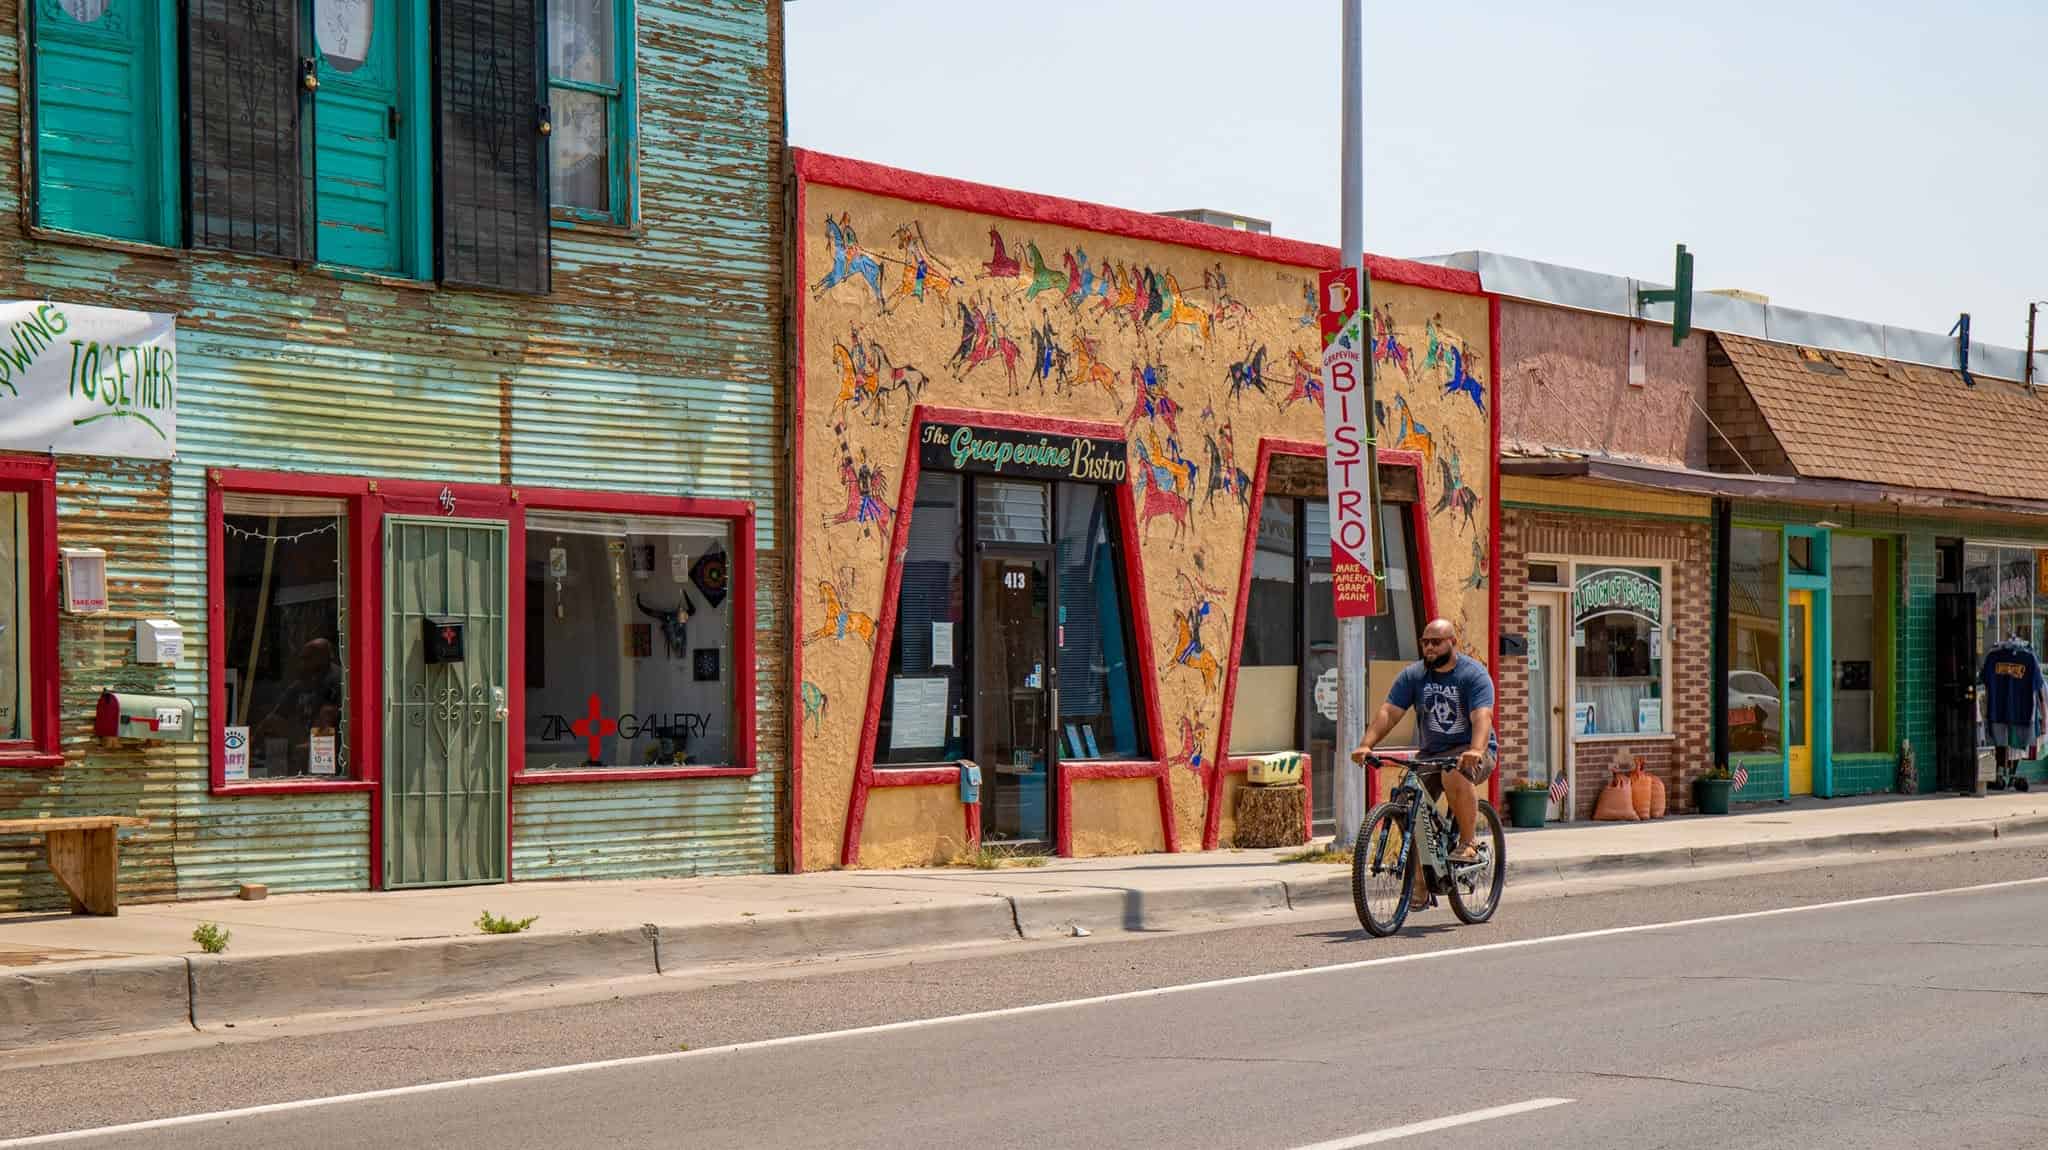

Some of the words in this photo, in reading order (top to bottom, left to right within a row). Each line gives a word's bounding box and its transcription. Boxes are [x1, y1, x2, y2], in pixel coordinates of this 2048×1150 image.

[70, 340, 174, 410] TOGETHER
[922, 425, 949, 444] The
[951, 426, 1070, 472] Grapevine
[1069, 438, 1126, 481] Bistro
[1332, 361, 1368, 550] BISTRO
[440, 486, 456, 516] 415
[1335, 573, 1372, 584] AMERICA
[1336, 563, 1360, 573] MAKE
[1005, 572, 1025, 588] 413
[1337, 583, 1366, 593] GRAPE
[1338, 592, 1370, 602] AGAIN!
[541, 714, 577, 742] ZIA
[617, 712, 712, 741] GALLERY
